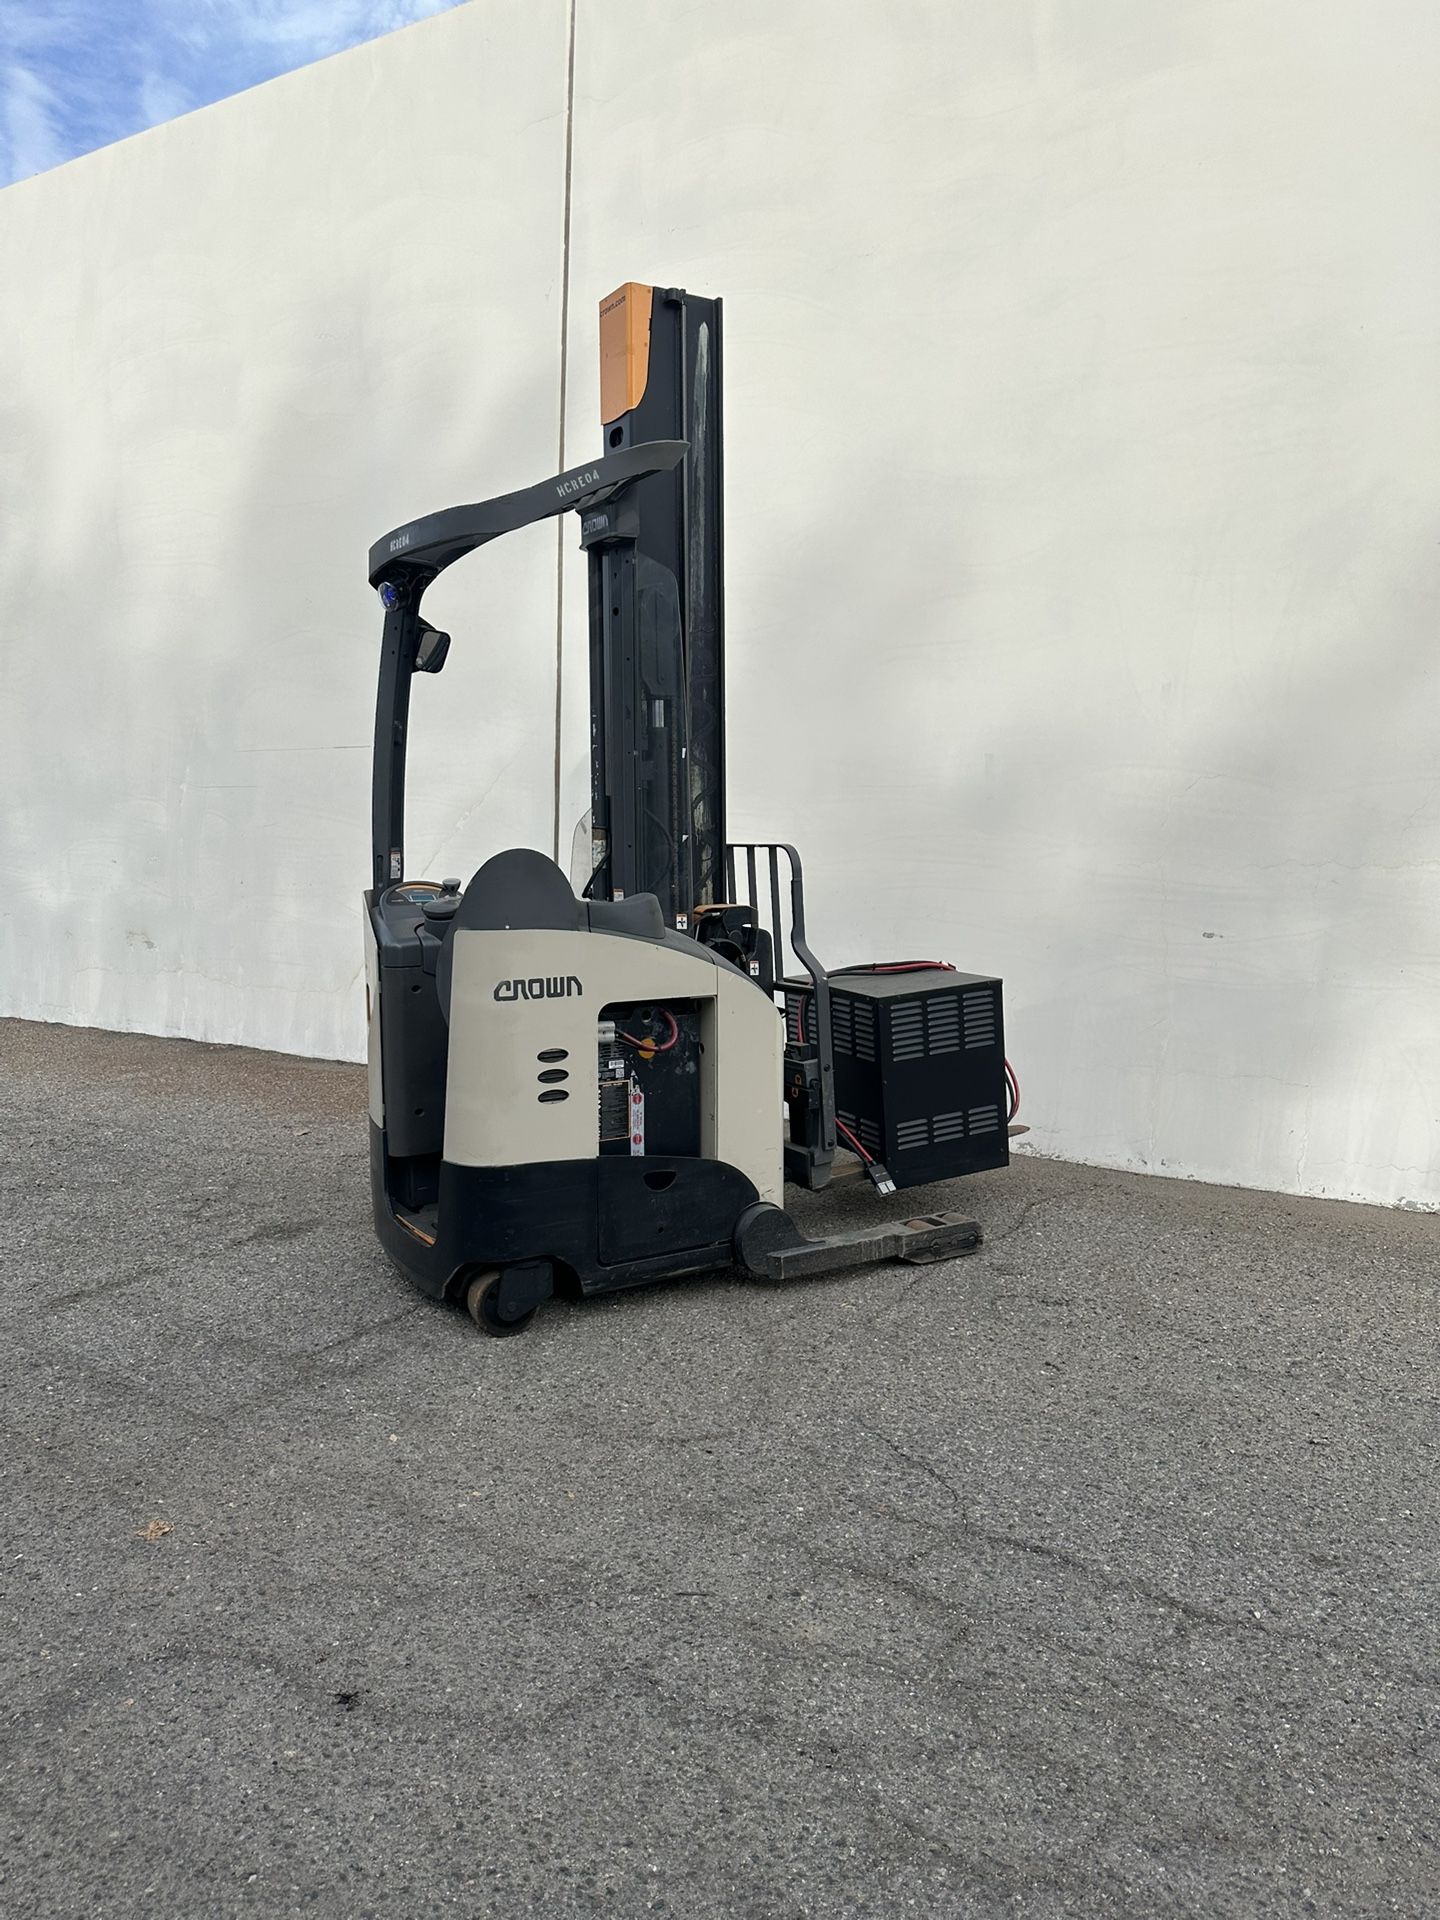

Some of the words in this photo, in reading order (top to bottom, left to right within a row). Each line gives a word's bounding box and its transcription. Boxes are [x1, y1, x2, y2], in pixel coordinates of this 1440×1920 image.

[556, 469, 600, 497] HCRE04
[583, 514, 609, 535] CROWN
[493, 975, 583, 1002] CROWN
